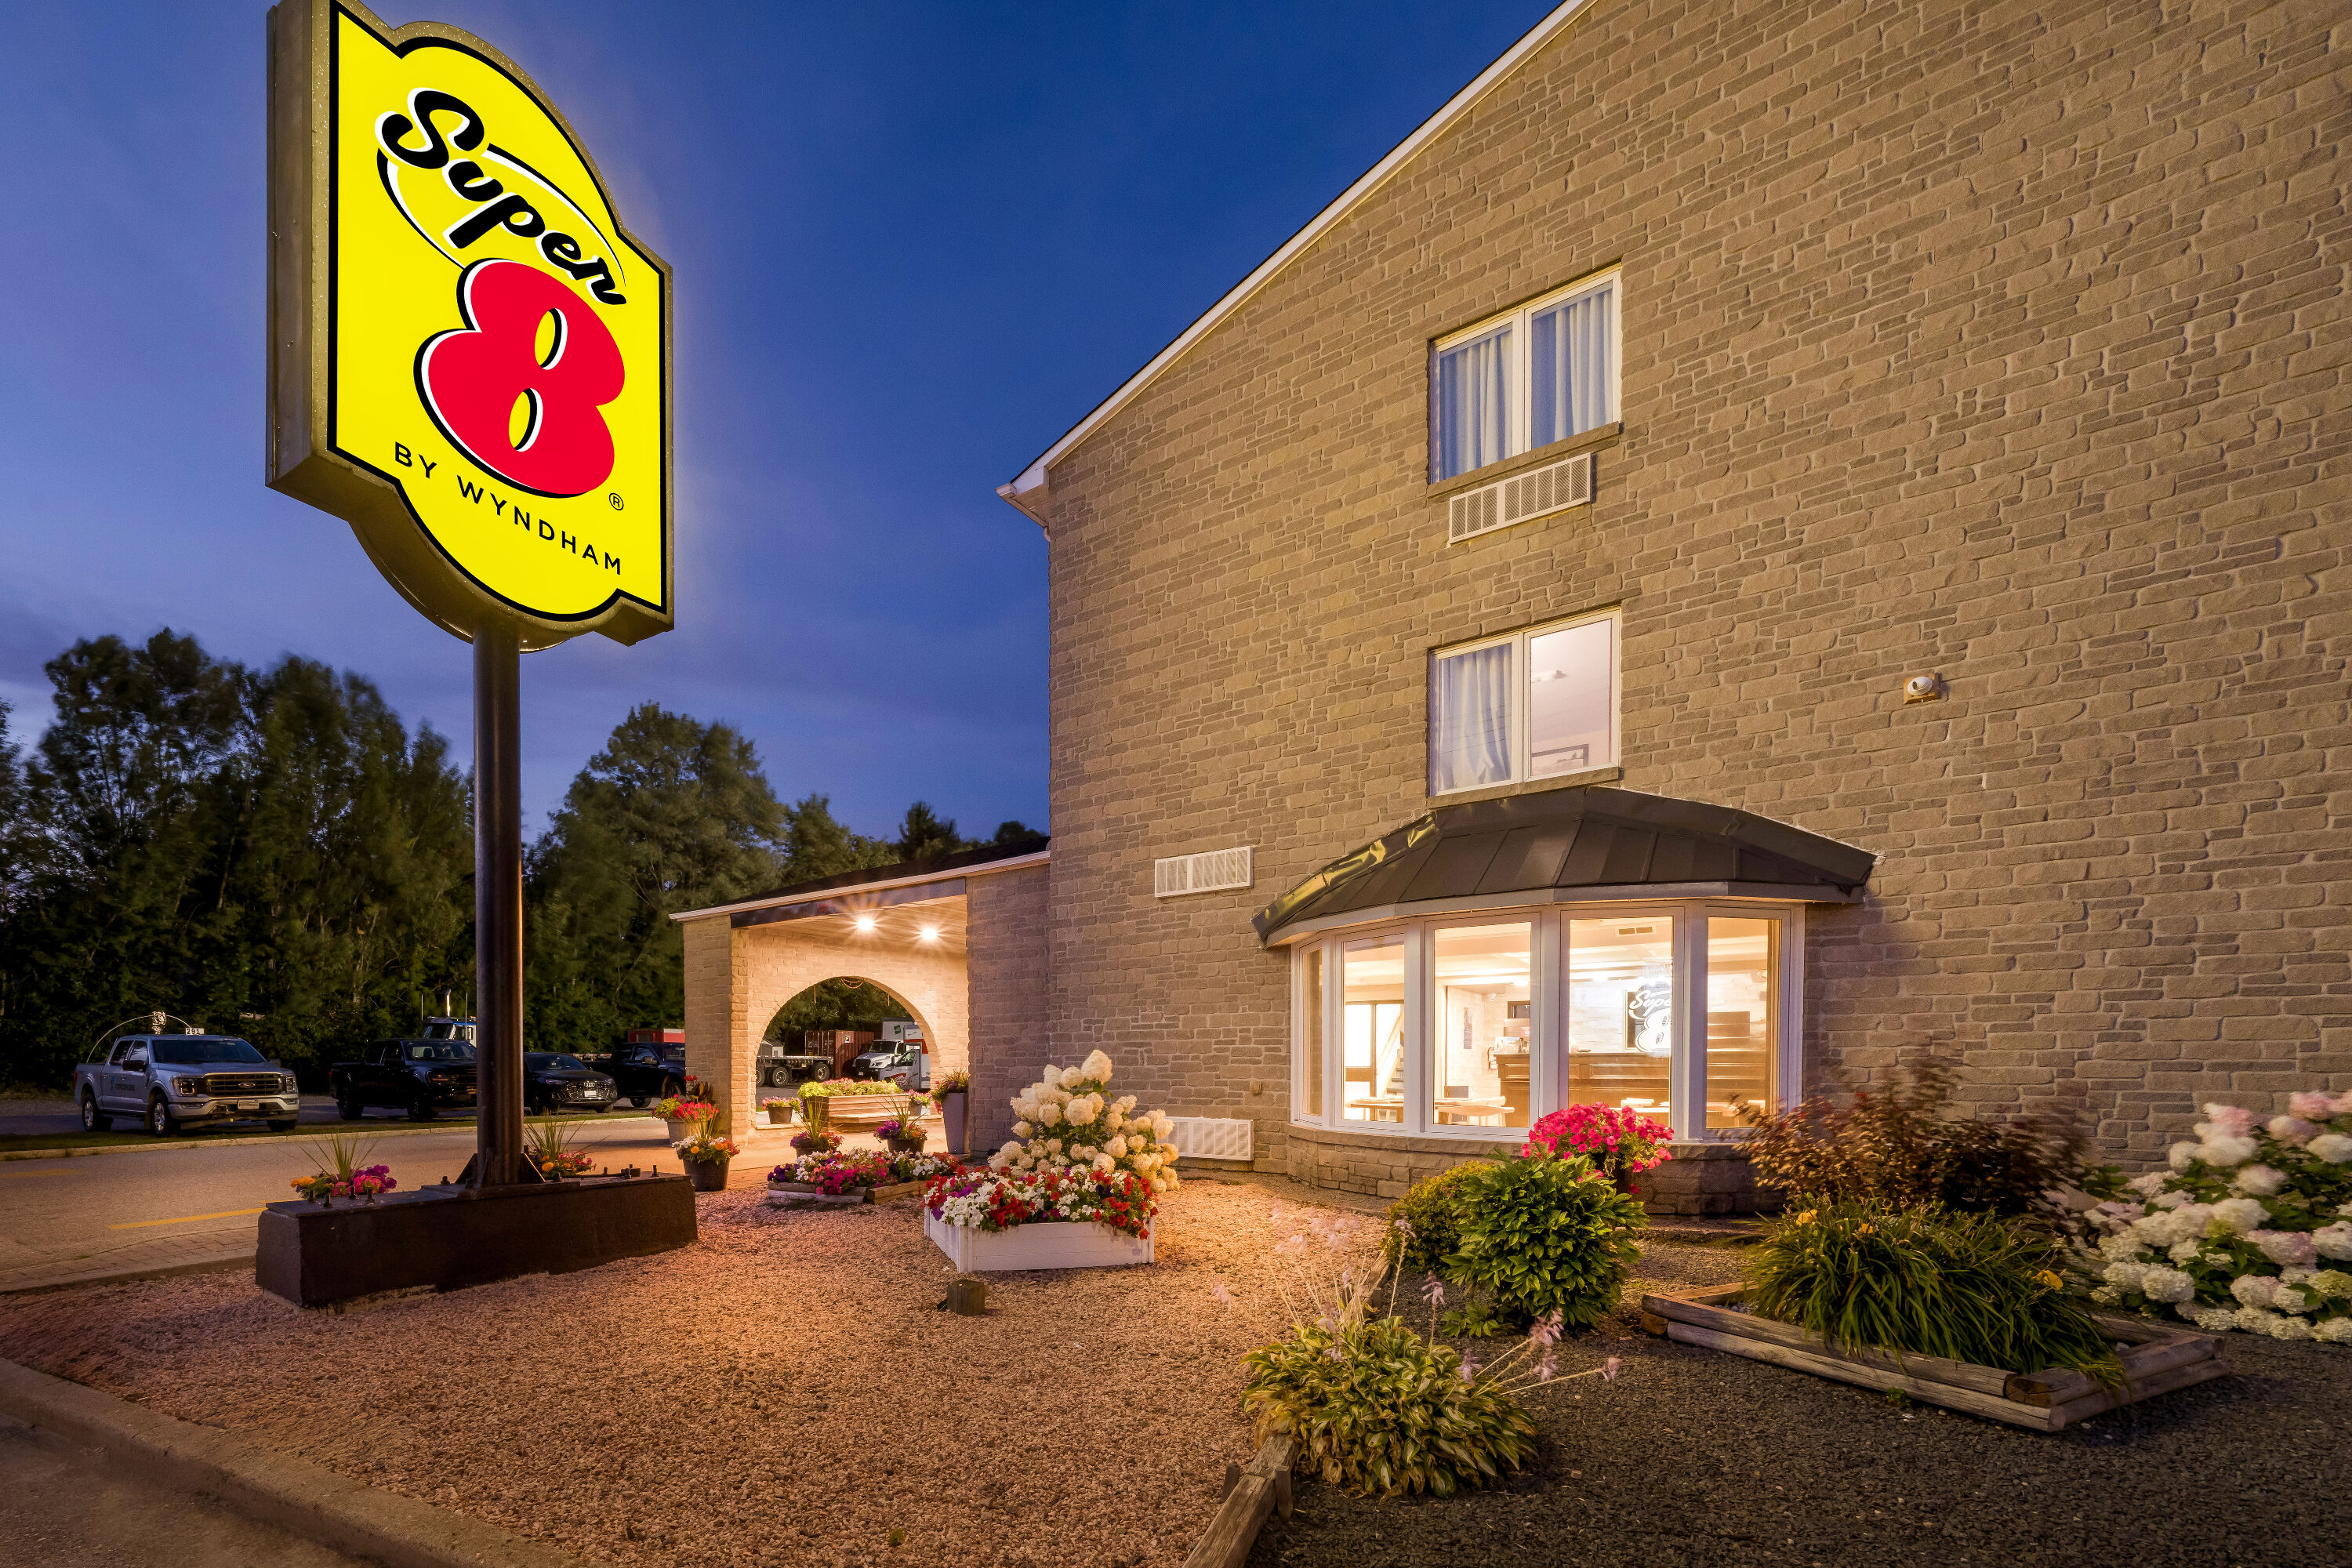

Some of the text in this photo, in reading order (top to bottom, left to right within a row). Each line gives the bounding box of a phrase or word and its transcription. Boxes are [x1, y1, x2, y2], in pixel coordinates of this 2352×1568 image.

[377, 89, 627, 306] Super
[413, 258, 626, 499] 8
[394, 441, 621, 575] BY WYNDHAM
